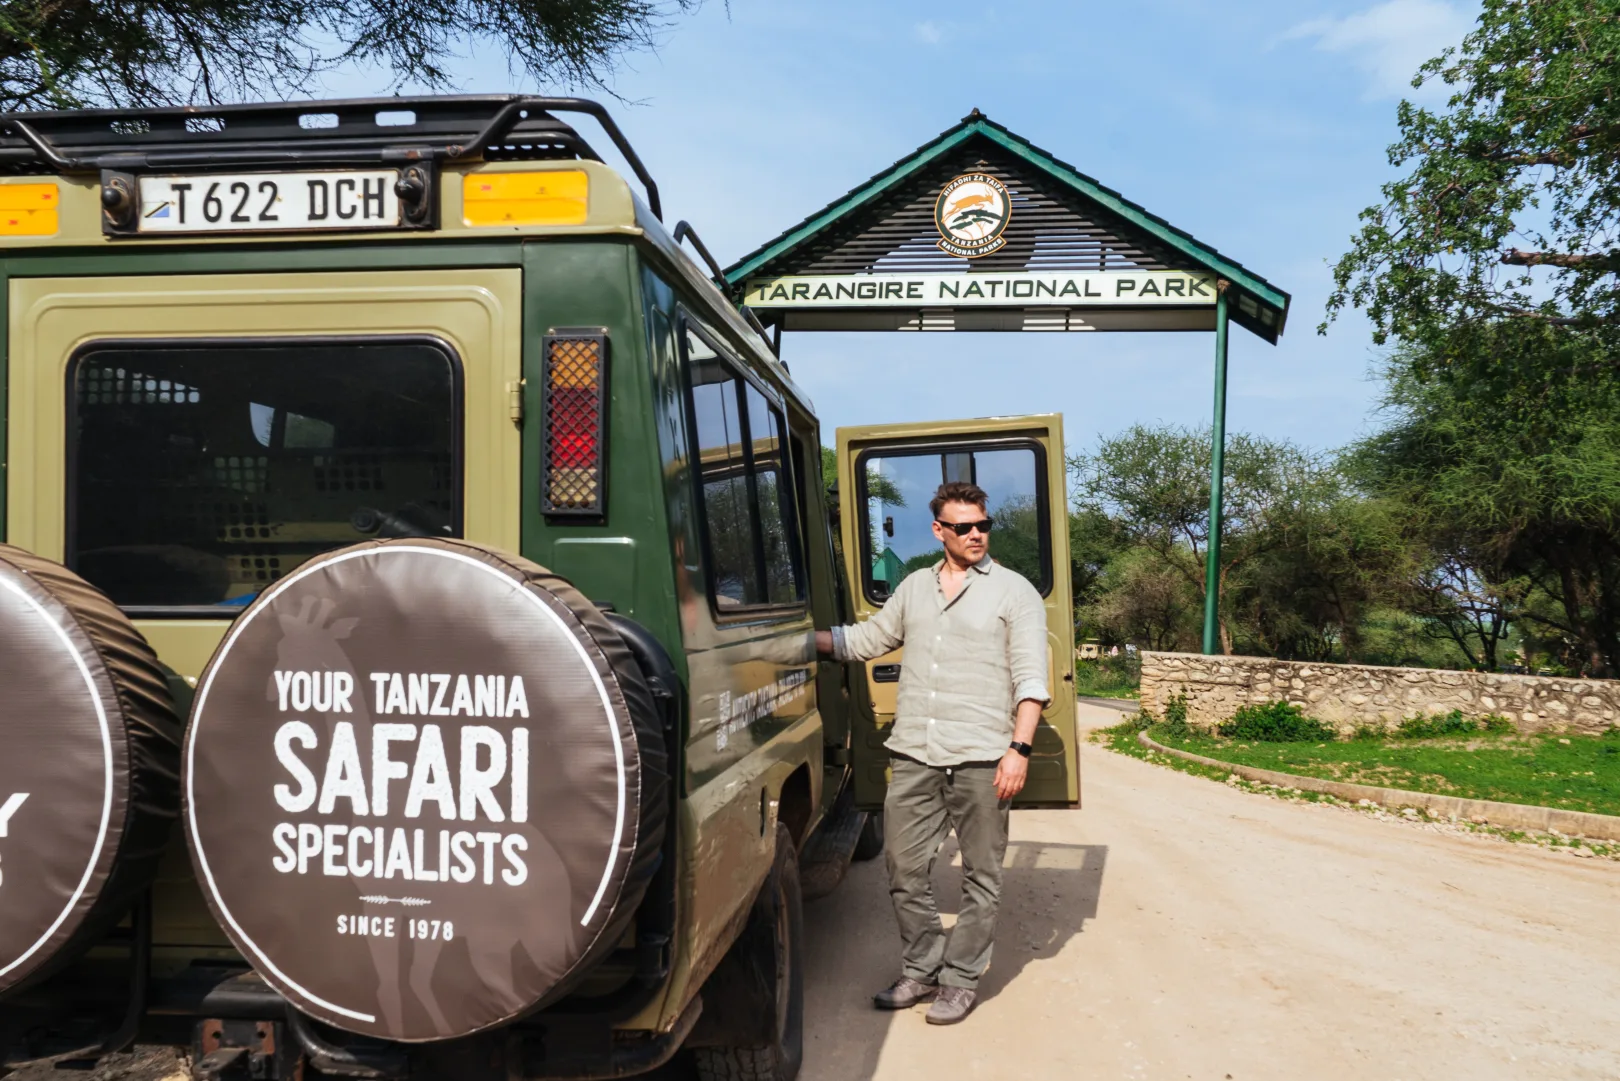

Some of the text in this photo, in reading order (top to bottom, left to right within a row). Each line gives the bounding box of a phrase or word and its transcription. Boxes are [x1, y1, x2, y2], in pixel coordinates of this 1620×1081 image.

[943, 176, 972, 197] HIFADHI
[986, 177, 1004, 194] TAIFA
[171, 177, 386, 224] T 622 DCH
[941, 238, 1003, 256] NATIONAL PARKS
[950, 234, 994, 247] TANZANIA
[753, 278, 1210, 301] TARANGIRE NATIONAL PARK
[274, 670, 530, 718] YOUR TANZANIA
[273, 720, 530, 823] SAFARI
[272, 822, 529, 886] SPECIALISTS
[336, 914, 454, 941] SINCE 1978
